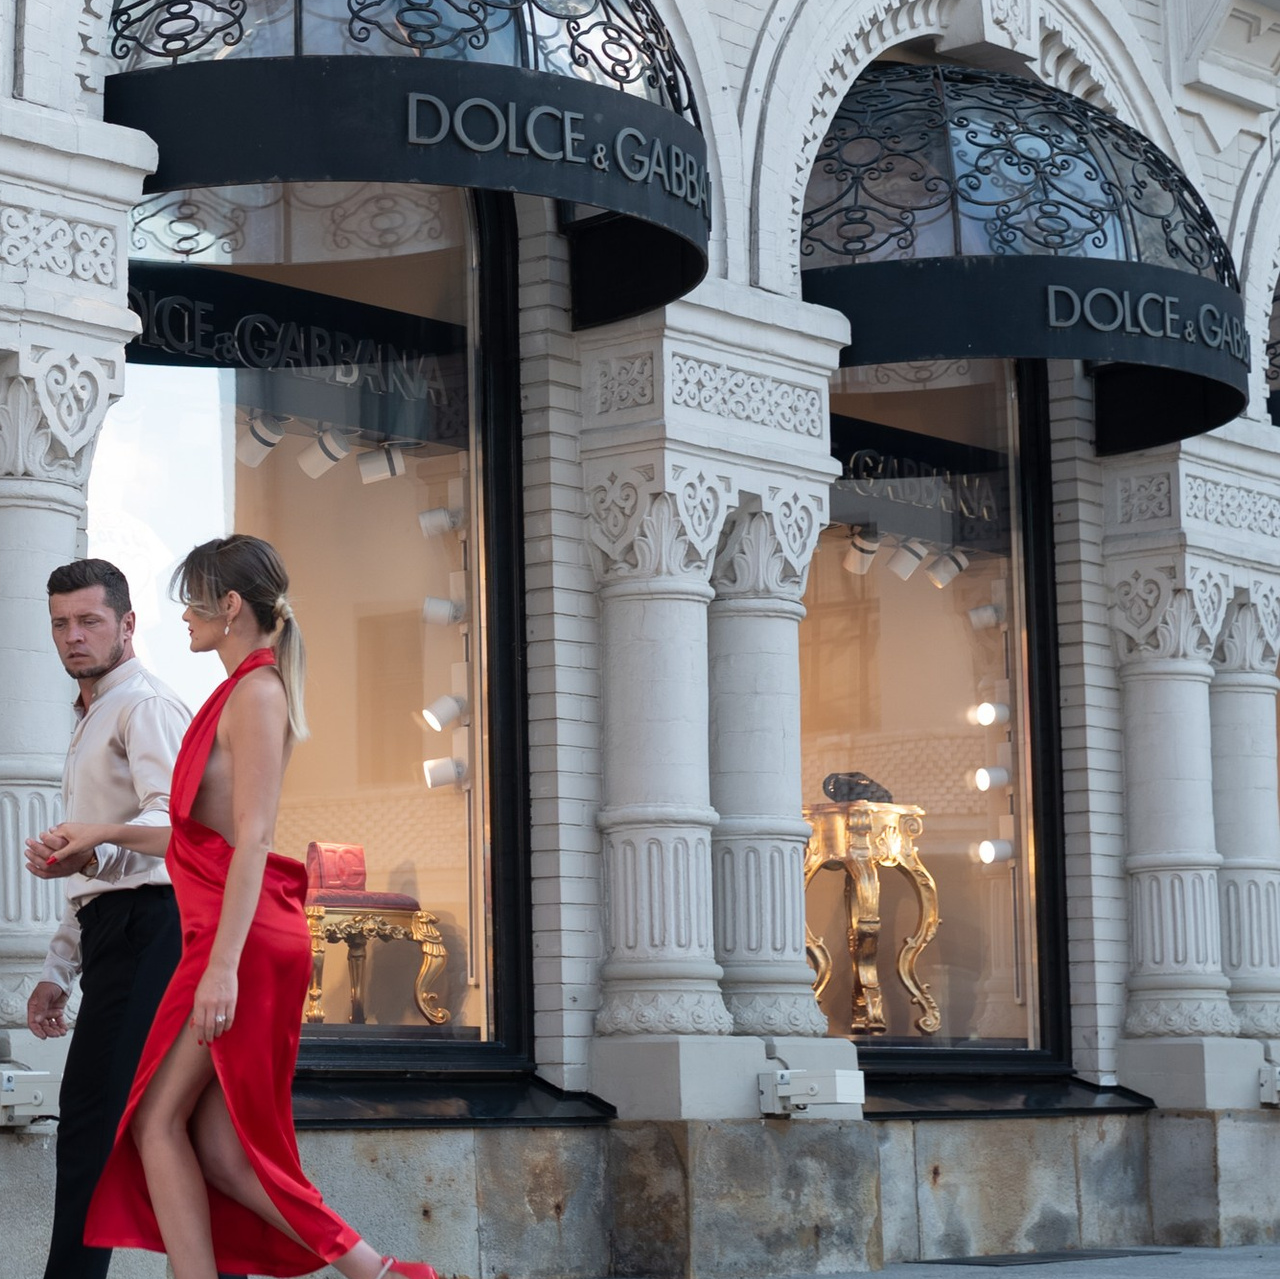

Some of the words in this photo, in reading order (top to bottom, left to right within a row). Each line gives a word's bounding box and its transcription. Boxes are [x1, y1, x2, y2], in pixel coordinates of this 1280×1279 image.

[408, 92, 587, 164] DOLCE
[593, 143, 610, 172] &
[614, 127, 711, 224] GABBA
[242, 313, 449, 406] GABBANA
[1046, 284, 1181, 340] DOLCE
[1183, 320, 1197, 344] &
[1198, 303, 1251, 367] GABB
[853, 449, 999, 521] GABBANA
